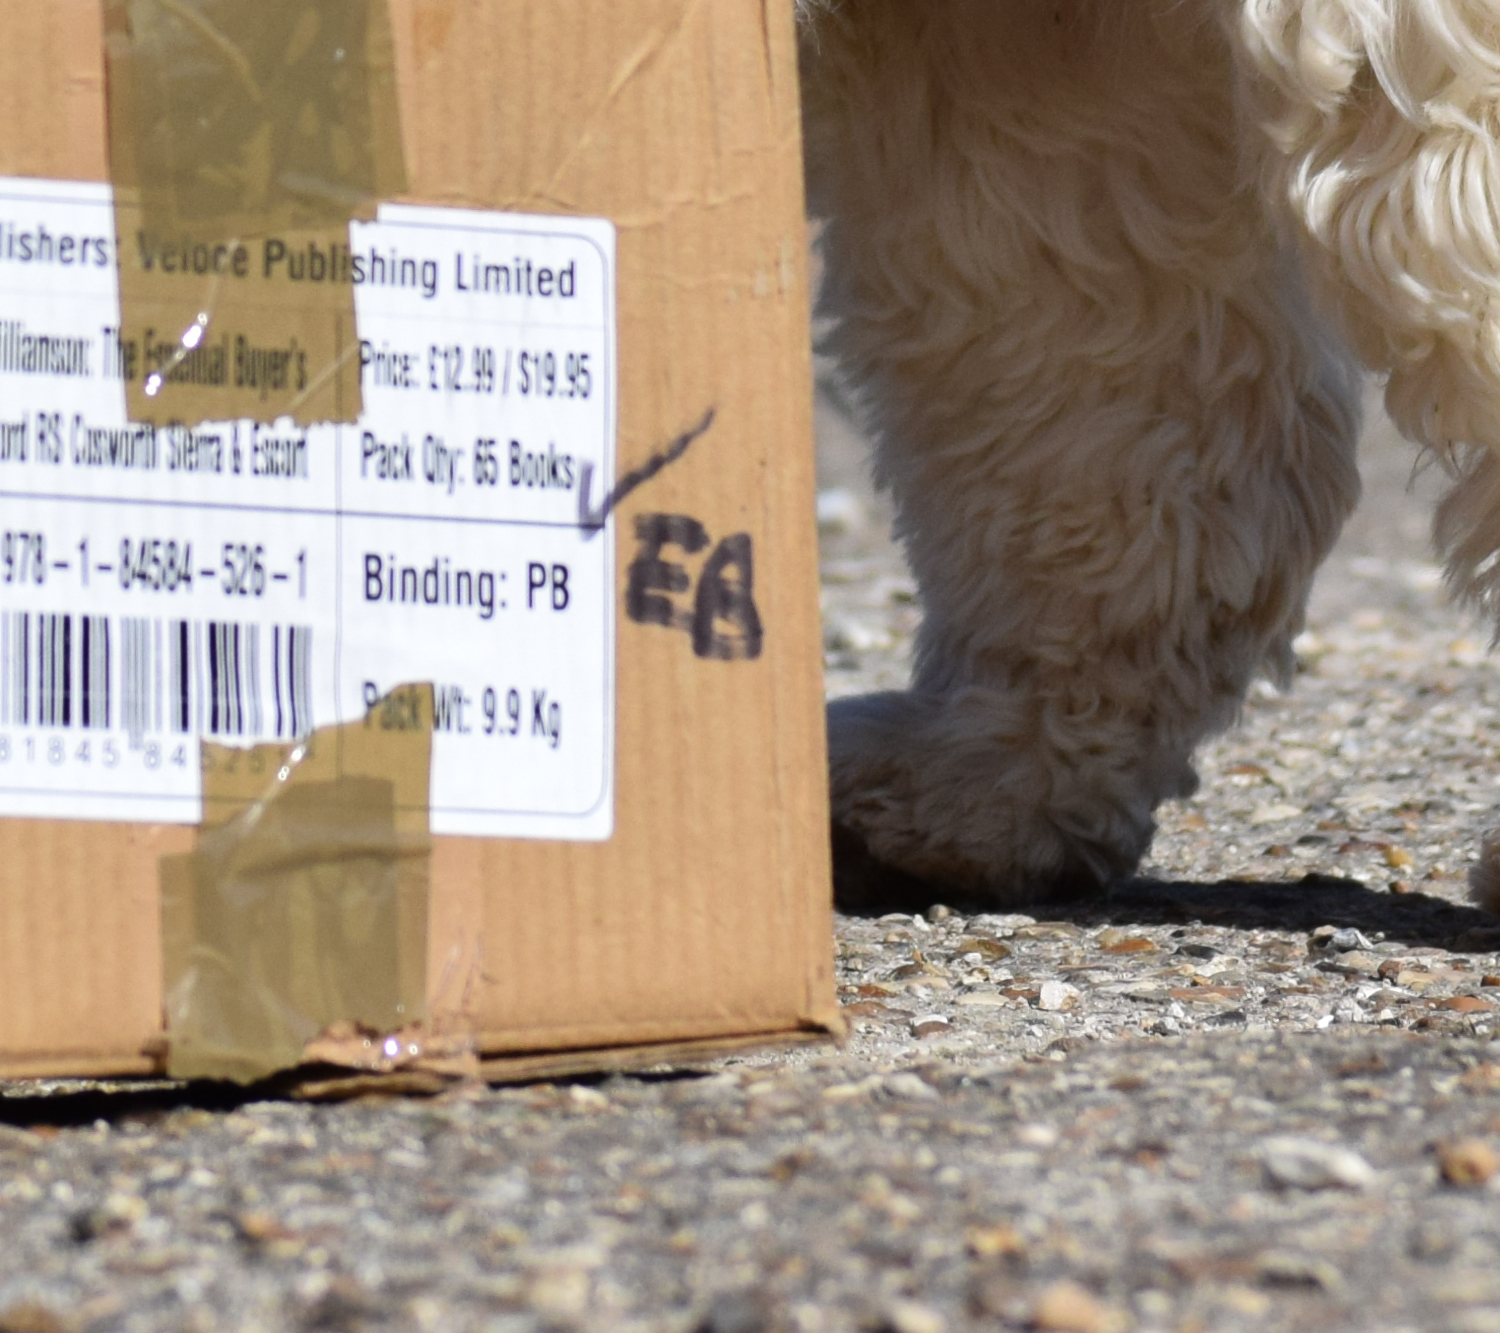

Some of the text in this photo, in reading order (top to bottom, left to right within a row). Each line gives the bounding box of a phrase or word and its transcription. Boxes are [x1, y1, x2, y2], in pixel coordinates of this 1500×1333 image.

[263, 237, 438, 298] Publishing
[455, 252, 576, 298] Limited
[101, 326, 136, 381] The
[358, 338, 592, 400] Price: £12.99 / $19.95
[34, 411, 64, 465] RS
[70, 414, 160, 470] Cosworth
[166, 419, 222, 473] Sierra
[252, 422, 309, 478] Escort
[360, 430, 415, 482] Pack
[422, 433, 465, 495] Qty:
[509, 439, 576, 491] Books
[364, 552, 572, 620] Binding: PB
[362, 681, 562, 749] Pack Wt: 9.9 Kg
